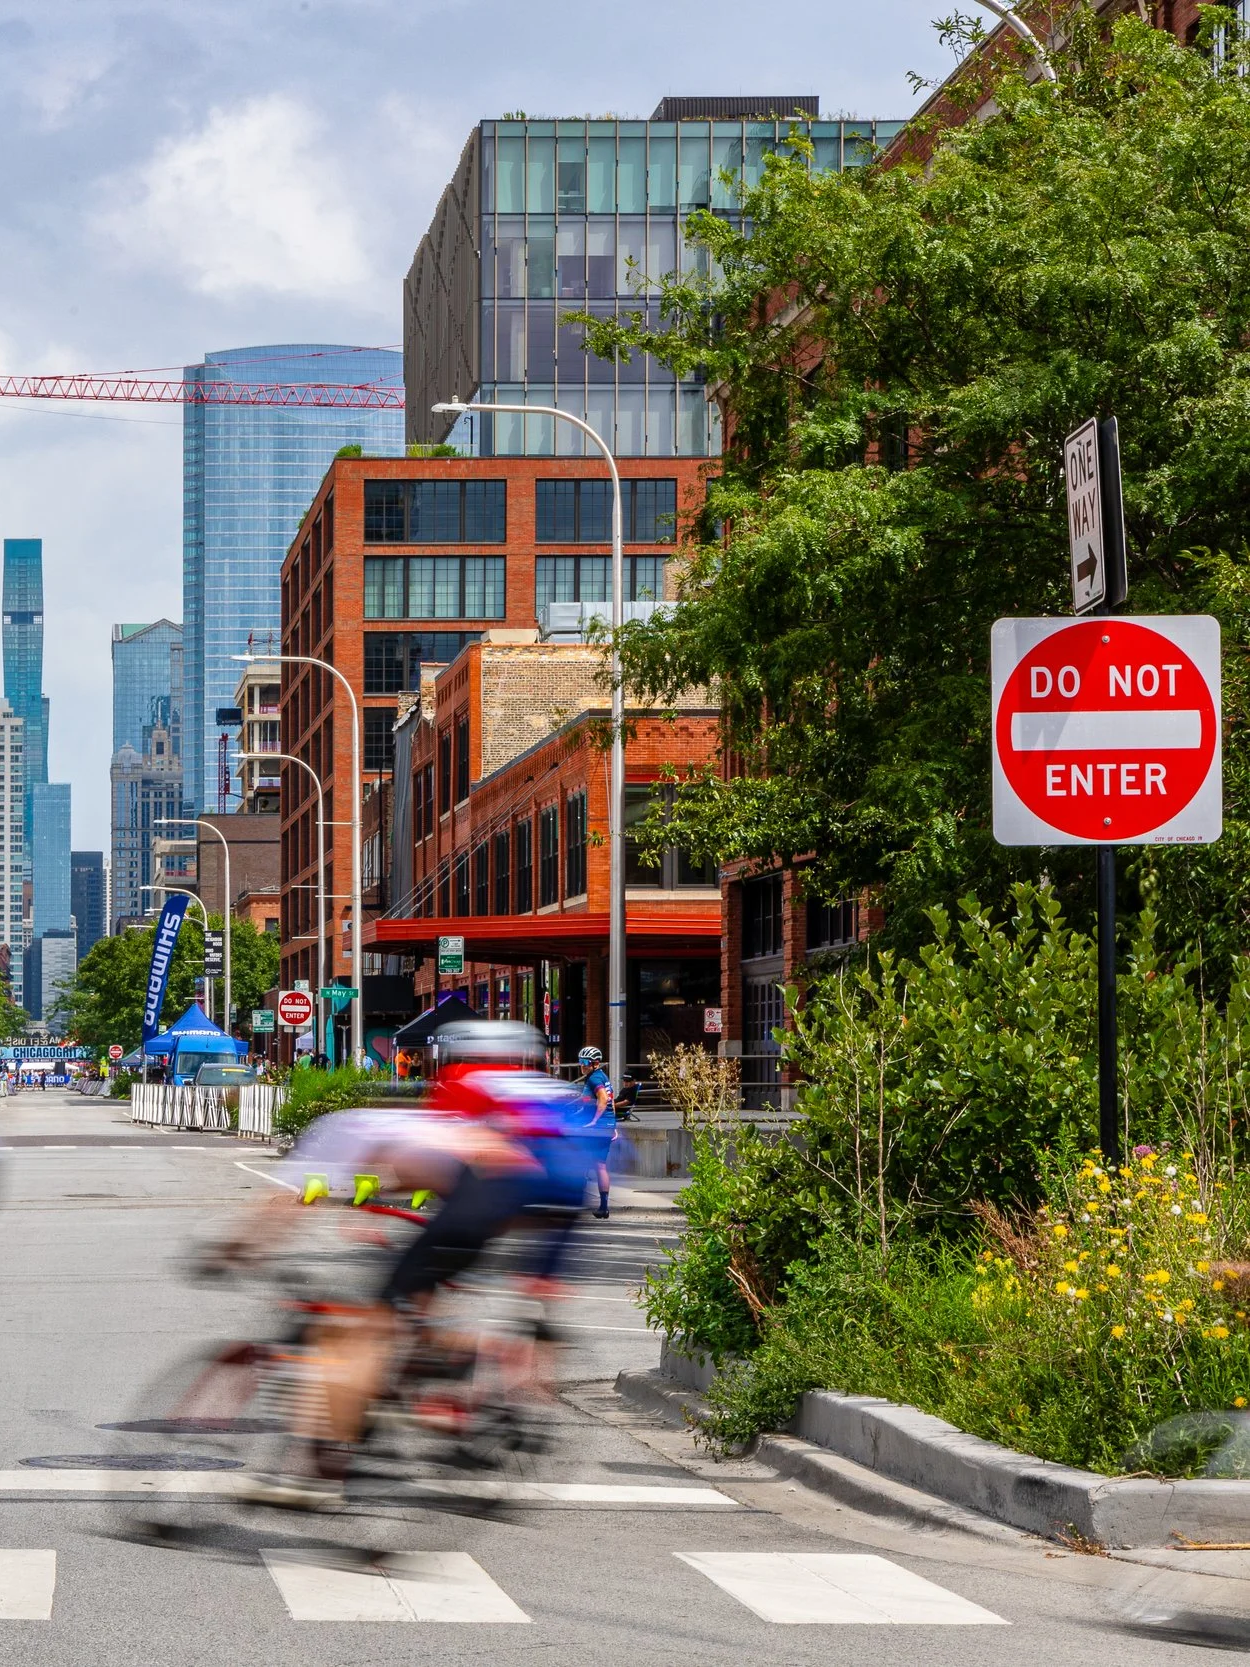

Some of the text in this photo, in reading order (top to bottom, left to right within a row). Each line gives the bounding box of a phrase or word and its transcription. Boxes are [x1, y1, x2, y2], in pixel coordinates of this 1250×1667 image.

[1070, 439, 1094, 492] ONE
[1072, 487, 1096, 541] WAY
[1030, 664, 1183, 698] DO NOT
[1046, 763, 1167, 797] ENTER
[144, 912, 181, 1026] SHIMANO
[332, 989, 346, 997] May
